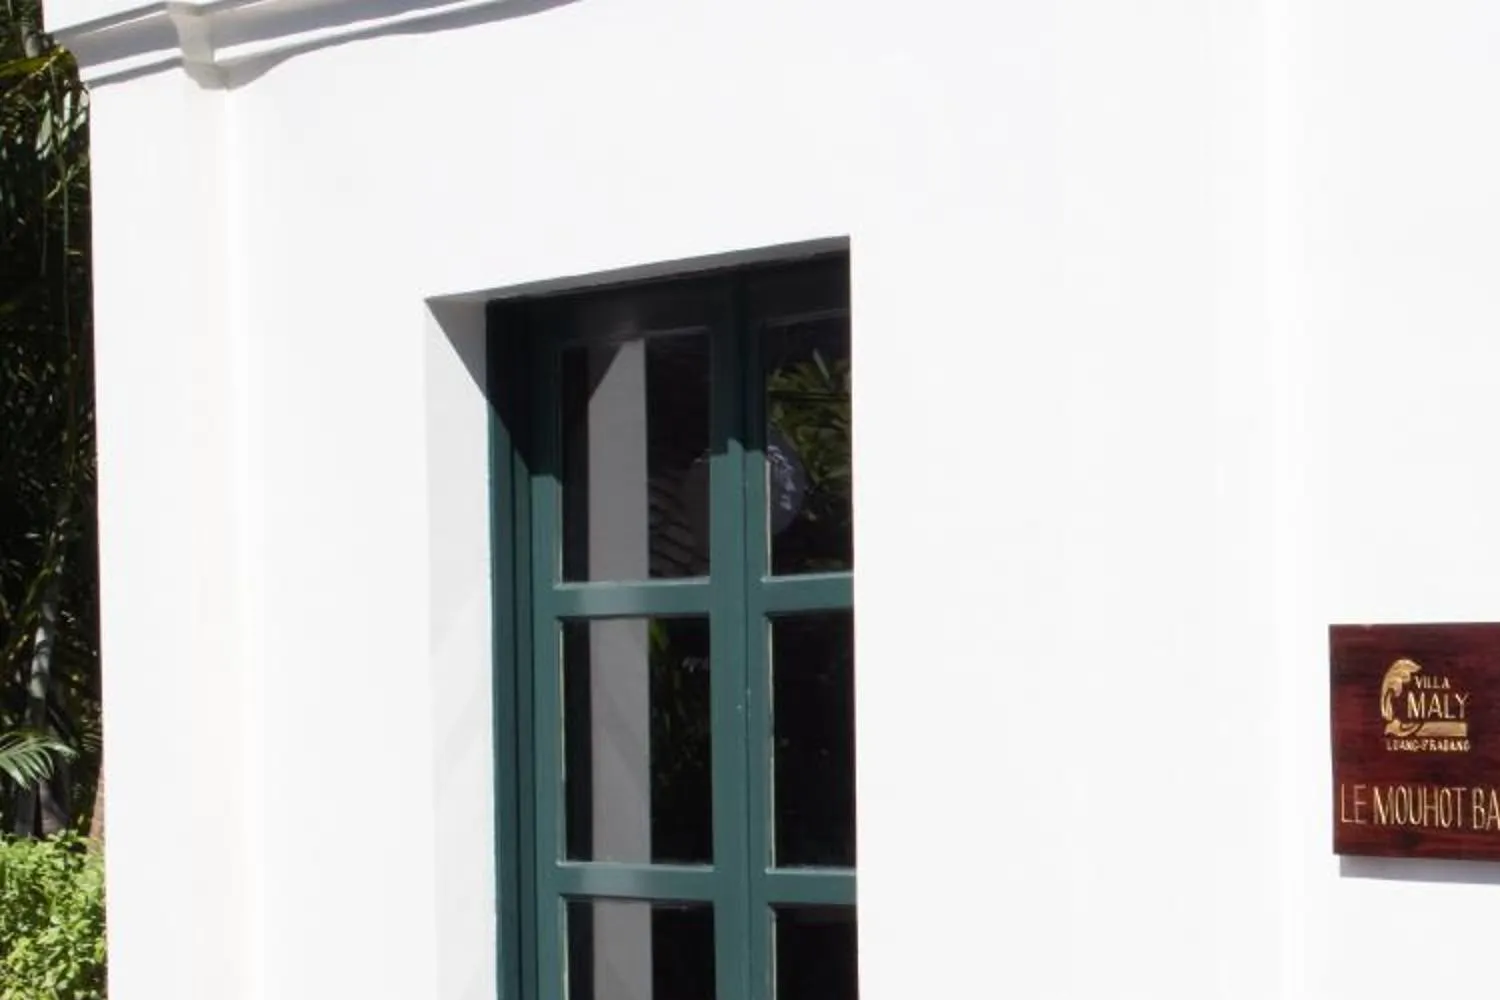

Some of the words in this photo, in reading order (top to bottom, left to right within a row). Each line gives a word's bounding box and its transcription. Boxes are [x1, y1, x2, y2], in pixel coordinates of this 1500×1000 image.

[1414, 675, 1450, 689] VILLA
[1407, 691, 1469, 719] MALY
[1341, 784, 1367, 824] LE
[1373, 785, 1467, 828] MOUHOT
